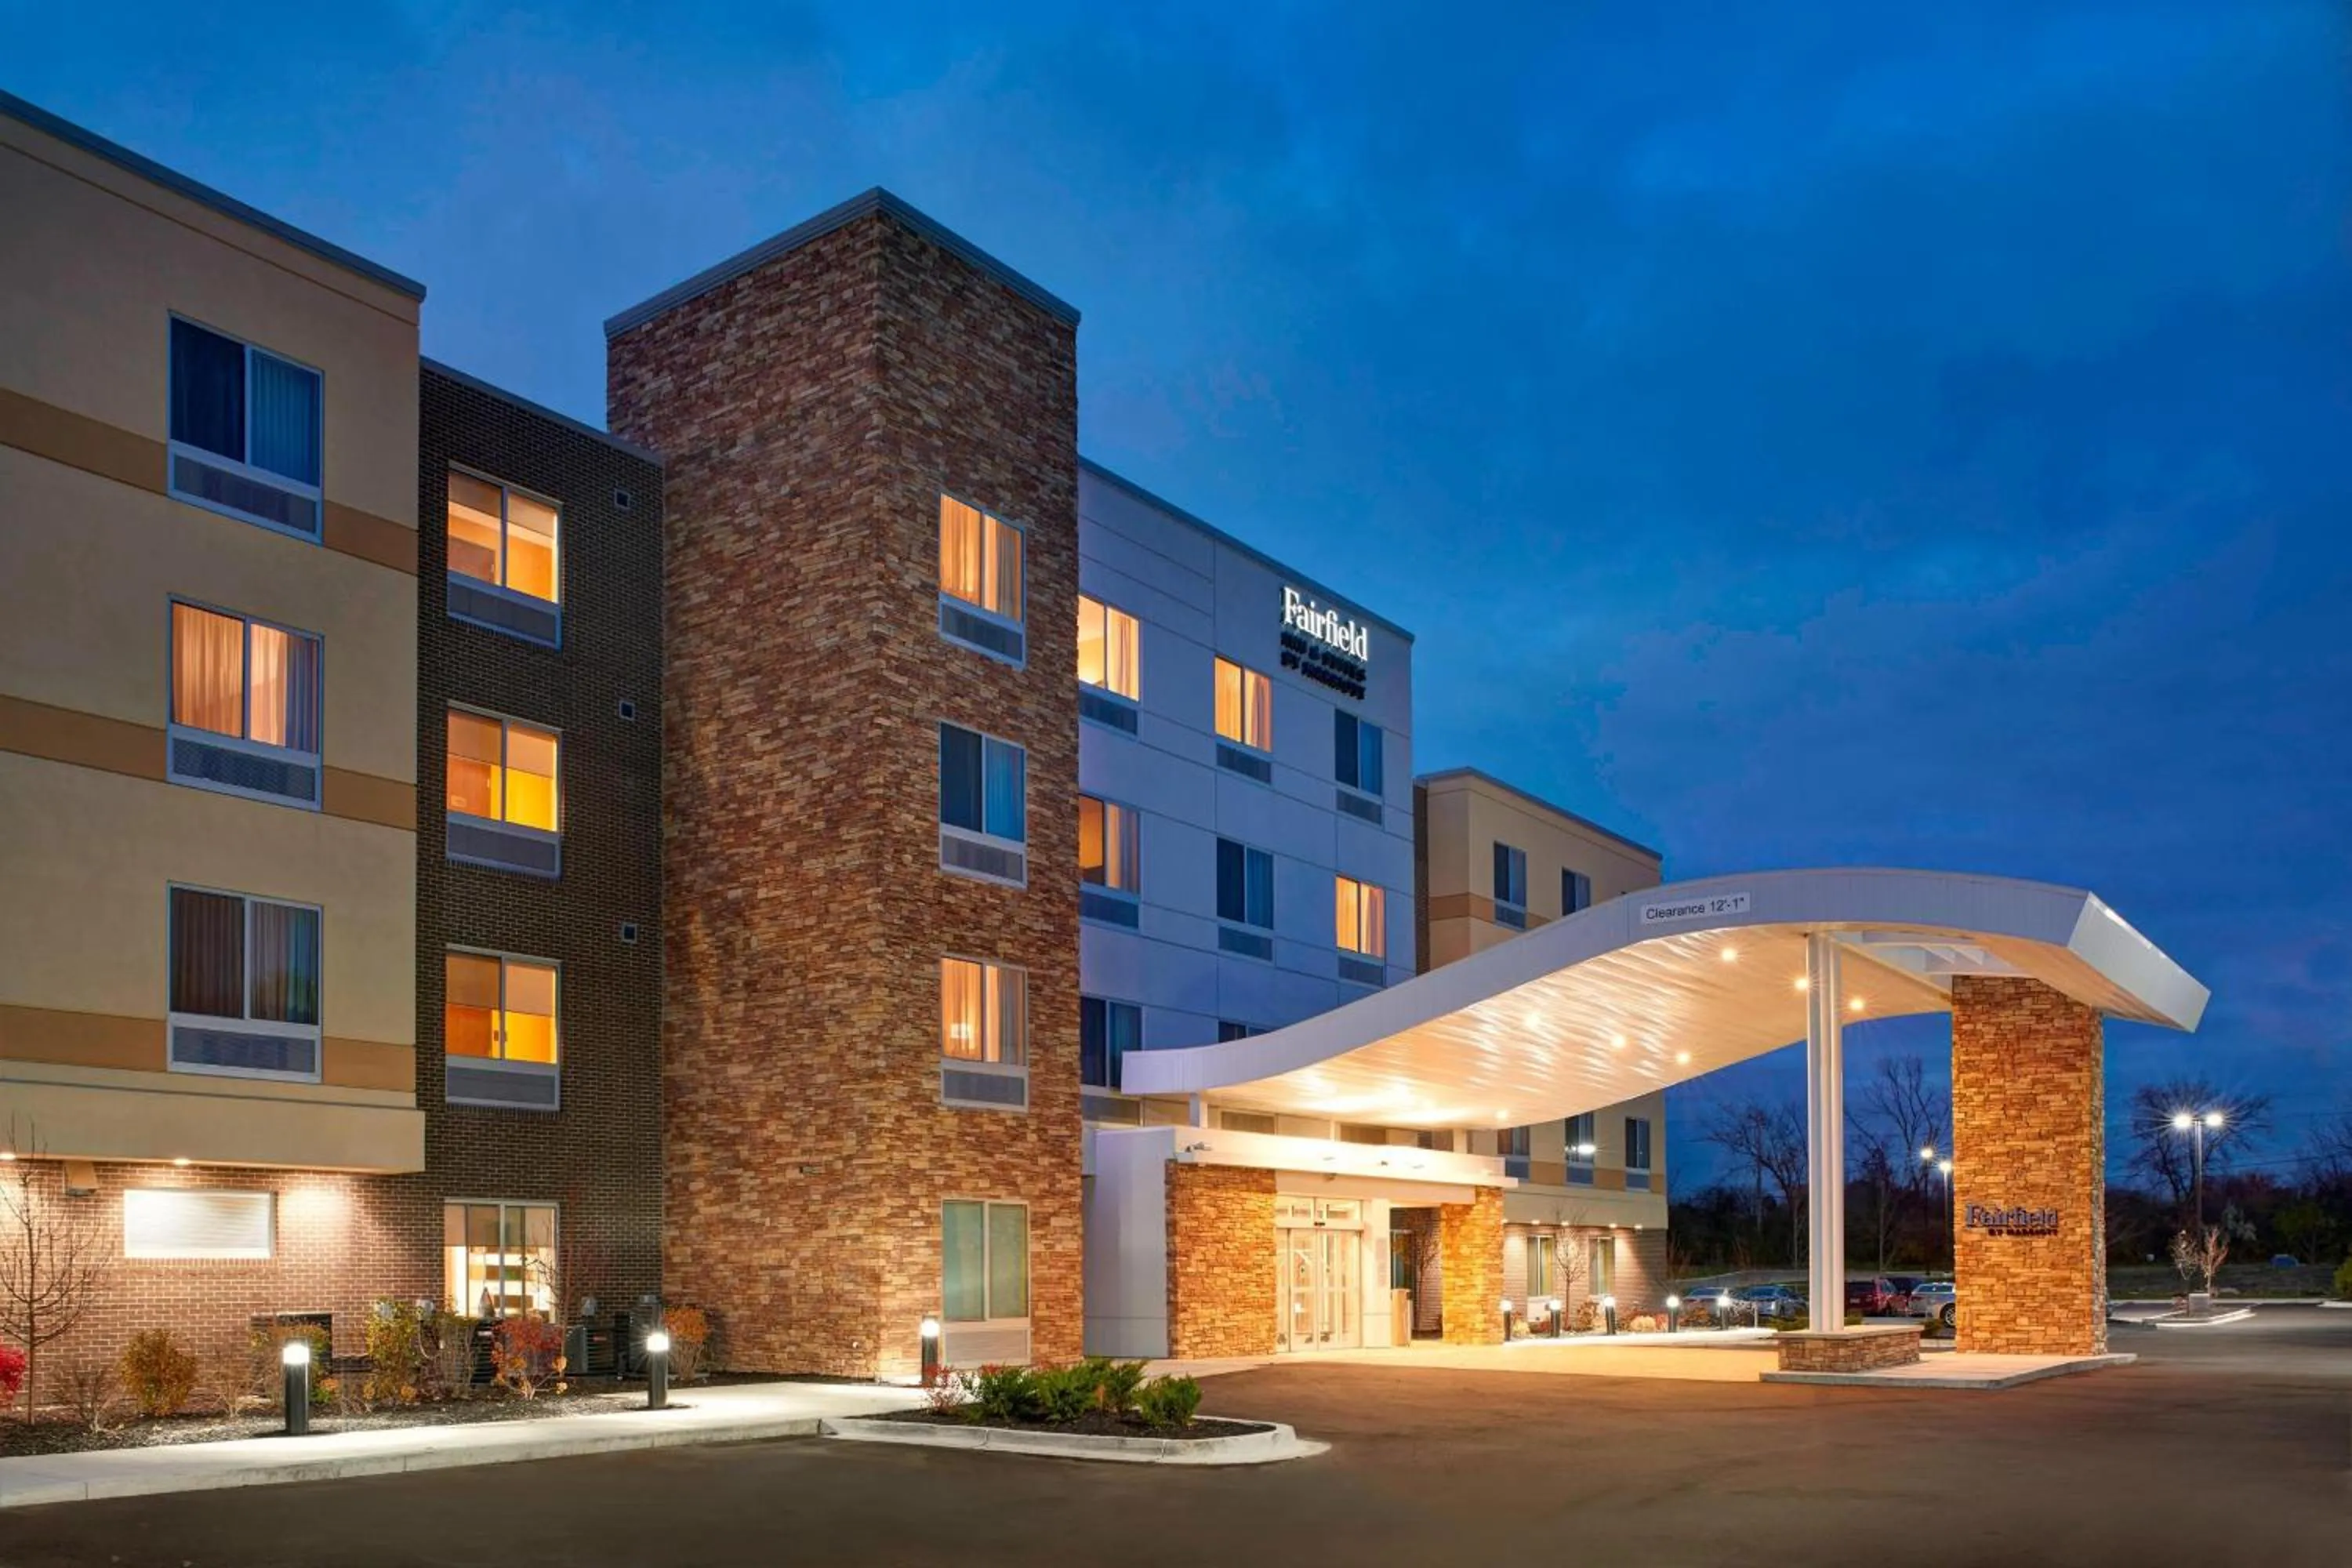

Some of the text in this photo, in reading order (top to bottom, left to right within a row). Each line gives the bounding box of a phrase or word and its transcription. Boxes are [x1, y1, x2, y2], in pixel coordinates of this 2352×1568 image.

[1283, 586, 1368, 661] Fairfield
[1646, 904, 1704, 920] Clearance
[1966, 1204, 2058, 1228] Fairfield
